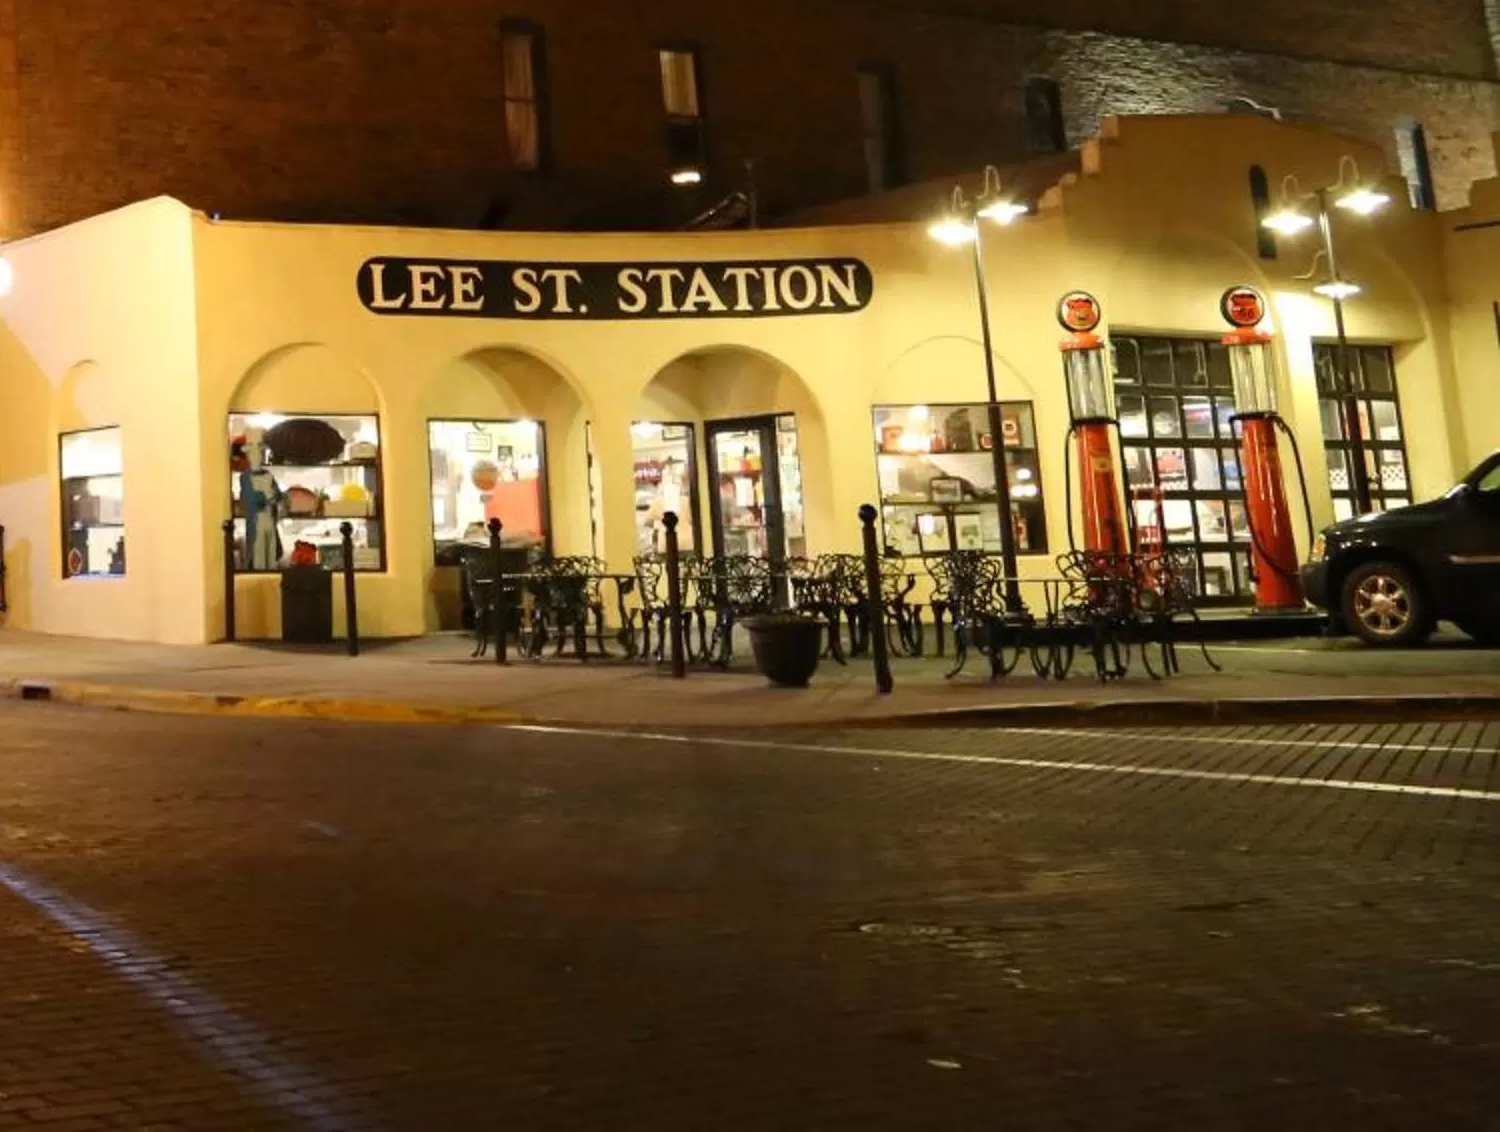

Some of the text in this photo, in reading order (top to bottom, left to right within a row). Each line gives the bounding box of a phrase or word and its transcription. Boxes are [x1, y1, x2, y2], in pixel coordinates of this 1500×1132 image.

[369, 264, 861, 313] LEE ST. STATION
